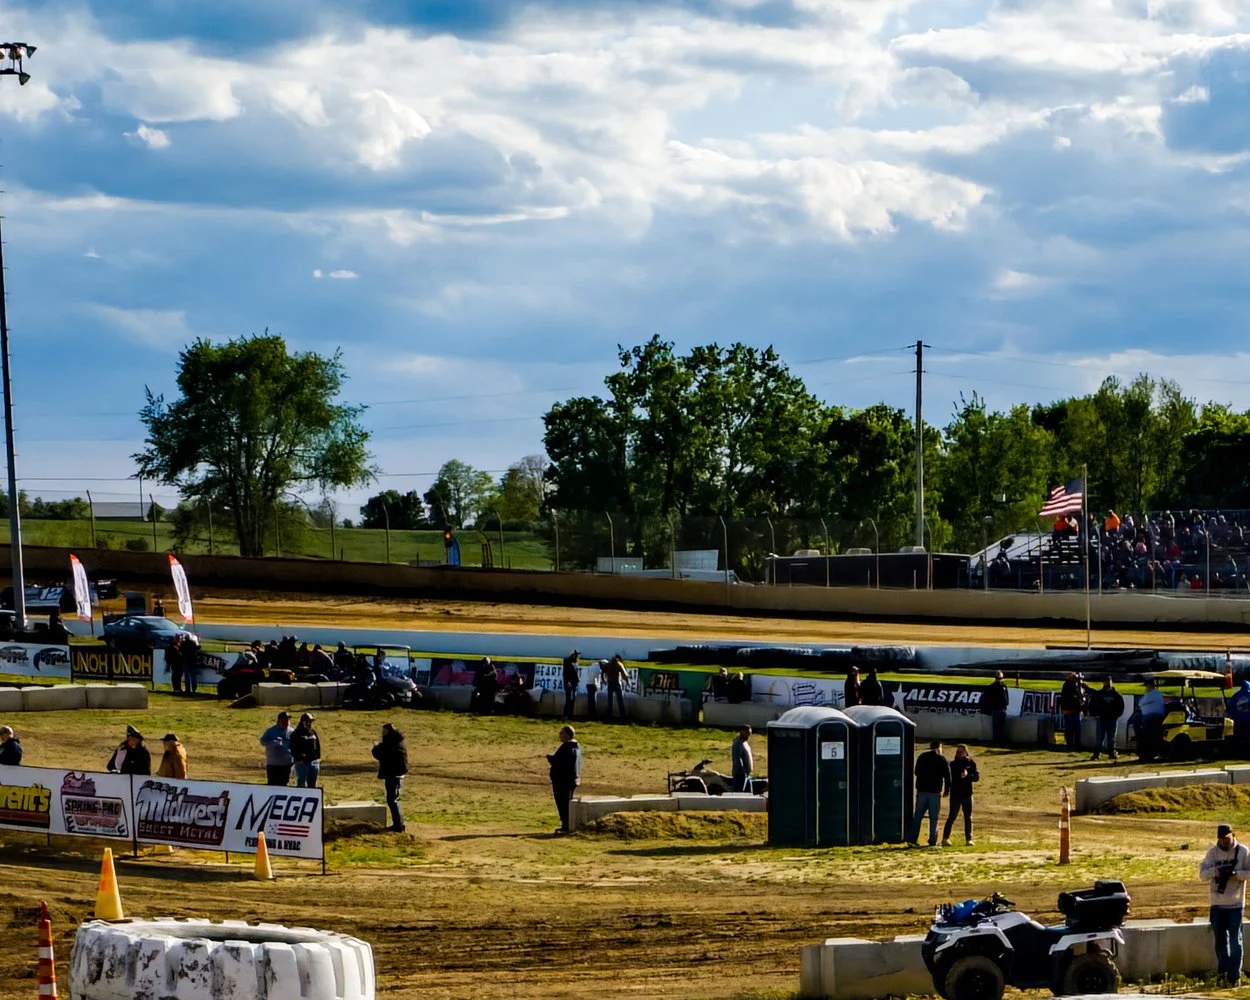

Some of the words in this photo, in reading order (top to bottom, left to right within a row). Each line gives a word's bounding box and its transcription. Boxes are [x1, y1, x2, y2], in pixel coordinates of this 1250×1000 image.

[72, 651, 108, 672] UNOH
[112, 653, 151, 674] UNOH
[905, 688, 982, 704] ALLSTAR
[136, 784, 230, 828] Midwest
[235, 793, 319, 833] MEGA
